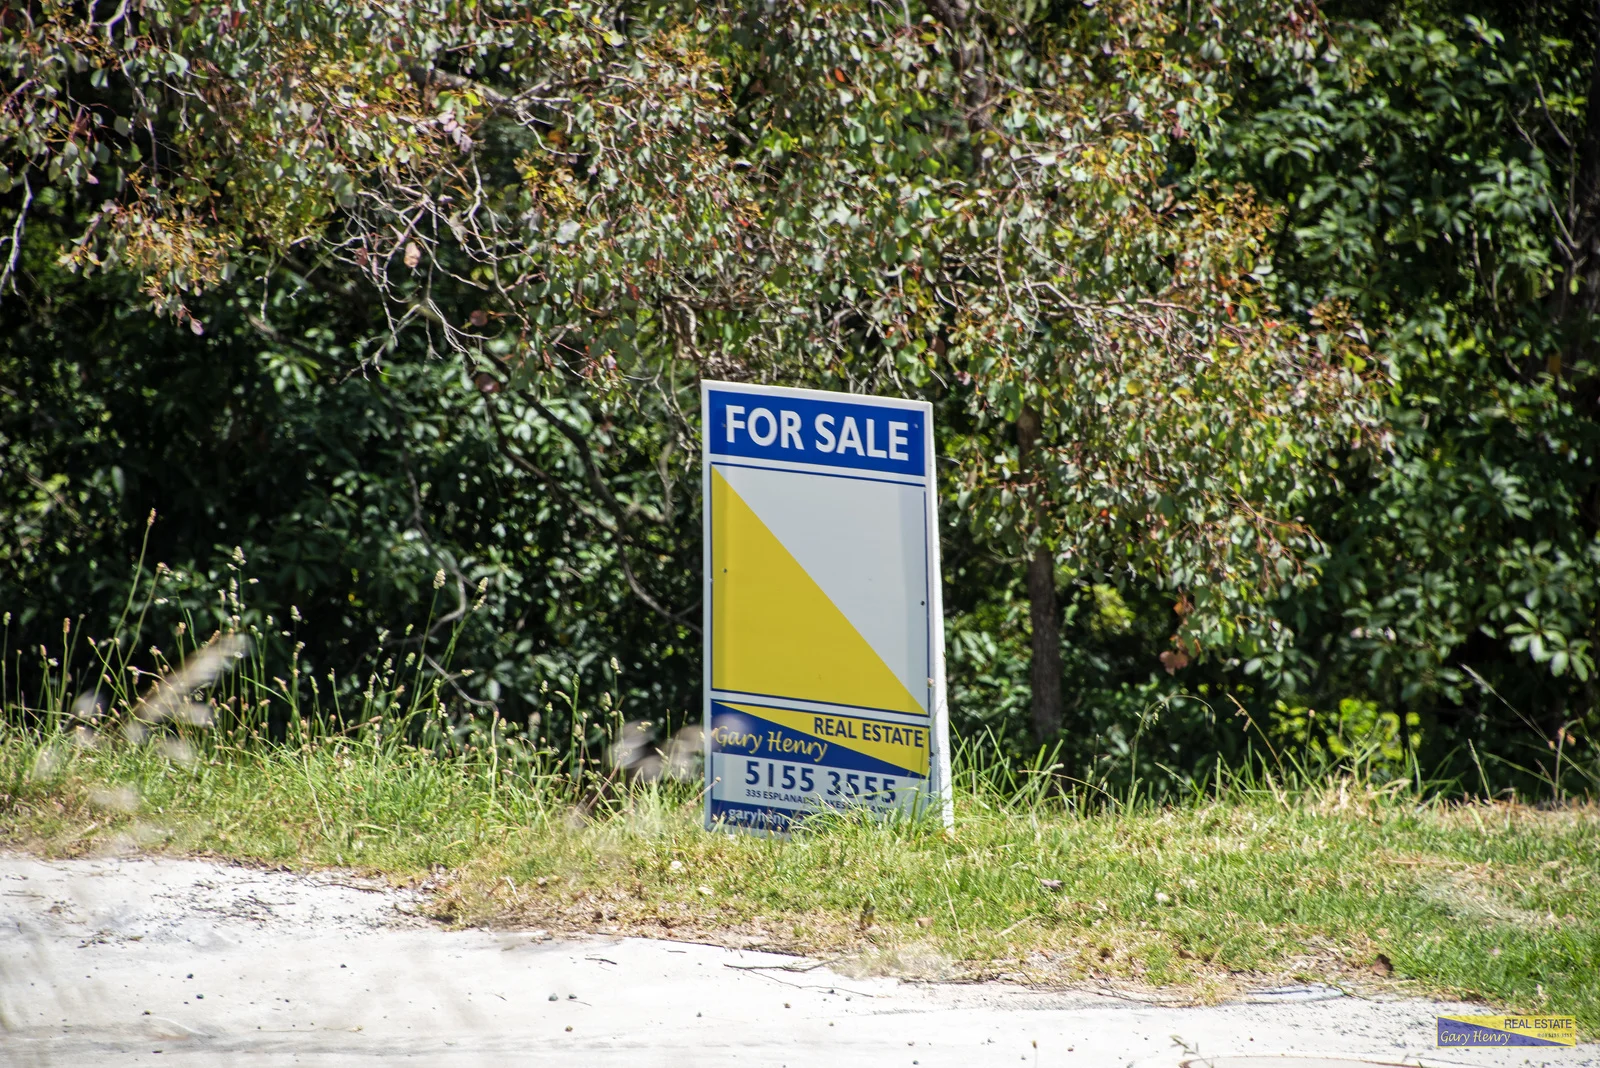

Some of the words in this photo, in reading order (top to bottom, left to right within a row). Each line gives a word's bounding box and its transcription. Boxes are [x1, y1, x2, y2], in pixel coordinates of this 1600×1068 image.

[725, 404, 805, 450] FOR
[814, 413, 909, 461] SALE
[714, 726, 763, 755] Gary
[767, 730, 828, 763] Henry
[814, 717, 858, 739] REAL
[862, 723, 924, 748] ESTATE
[745, 760, 814, 792] 5155
[827, 770, 897, 803] 3555
[745, 789, 761, 798] 335
[818, 797, 846, 809] AKES
